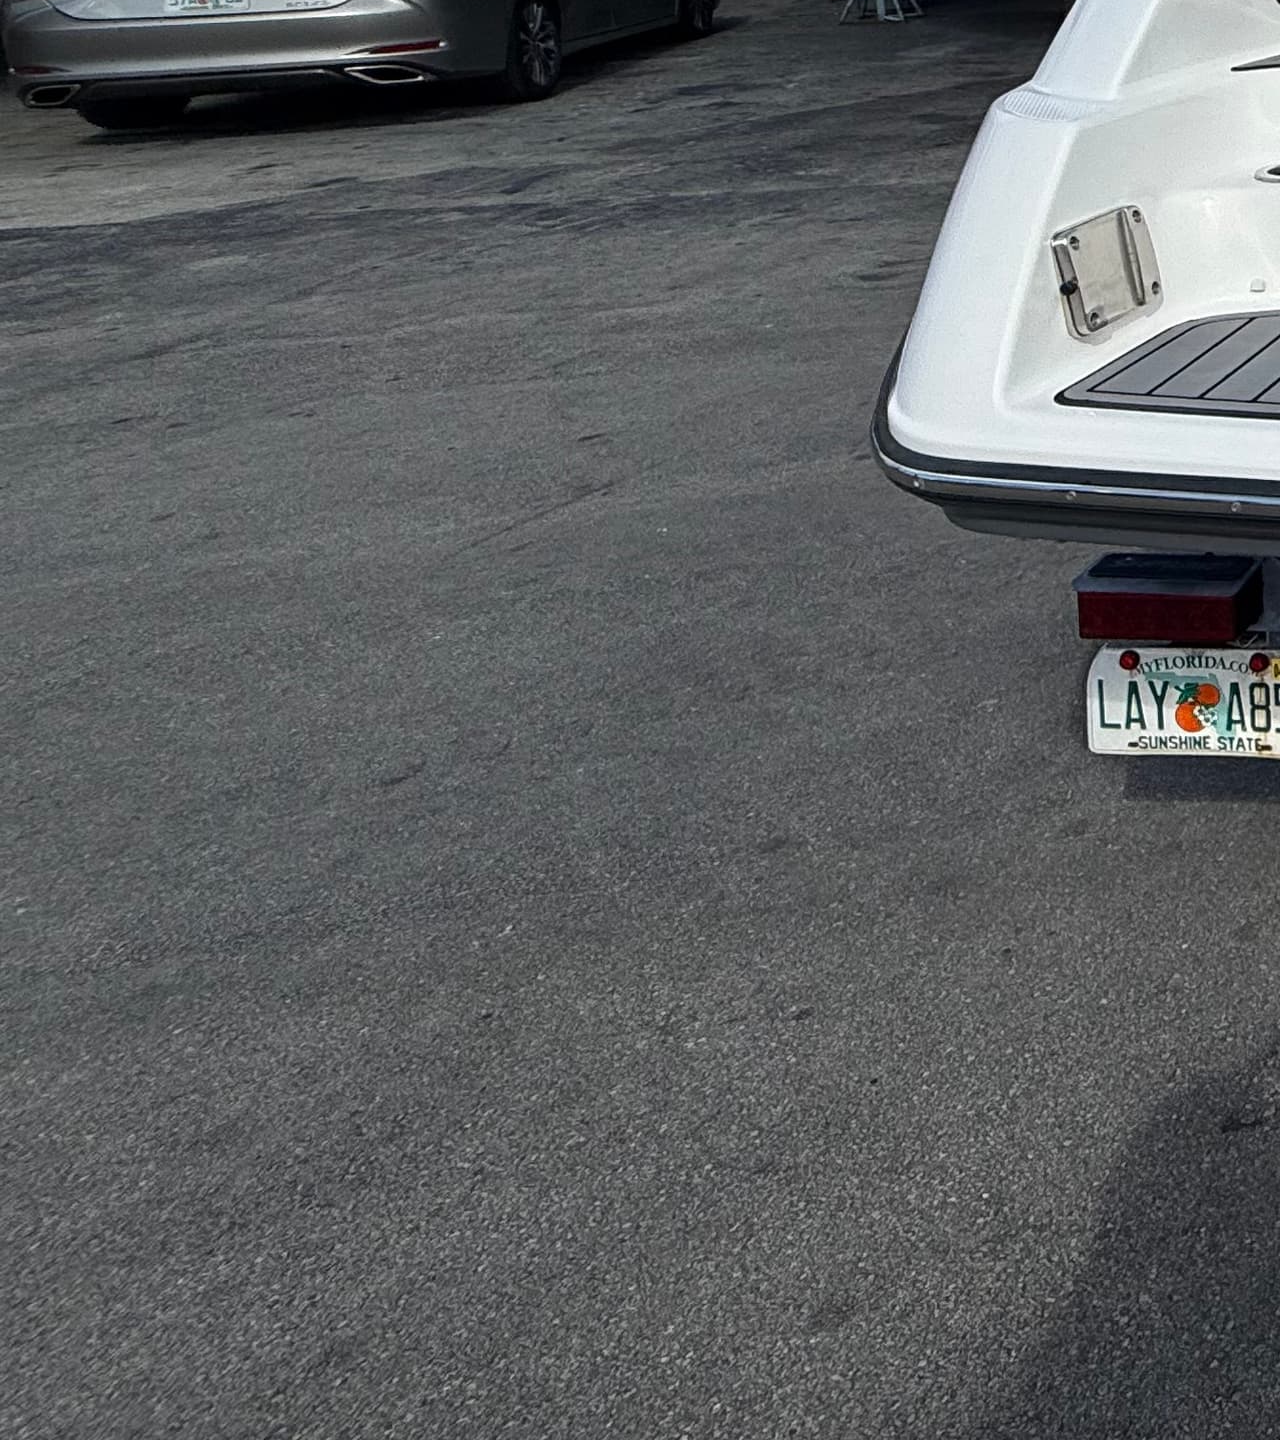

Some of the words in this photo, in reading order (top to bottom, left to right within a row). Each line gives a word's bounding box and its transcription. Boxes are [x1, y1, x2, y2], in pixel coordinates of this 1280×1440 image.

[1136, 655, 1260, 678] MYFLORIDA.CO
[1098, 679, 1170, 731] LAY
[1138, 735, 1211, 750] SUNSHINE
[1218, 737, 1263, 752] STATE
